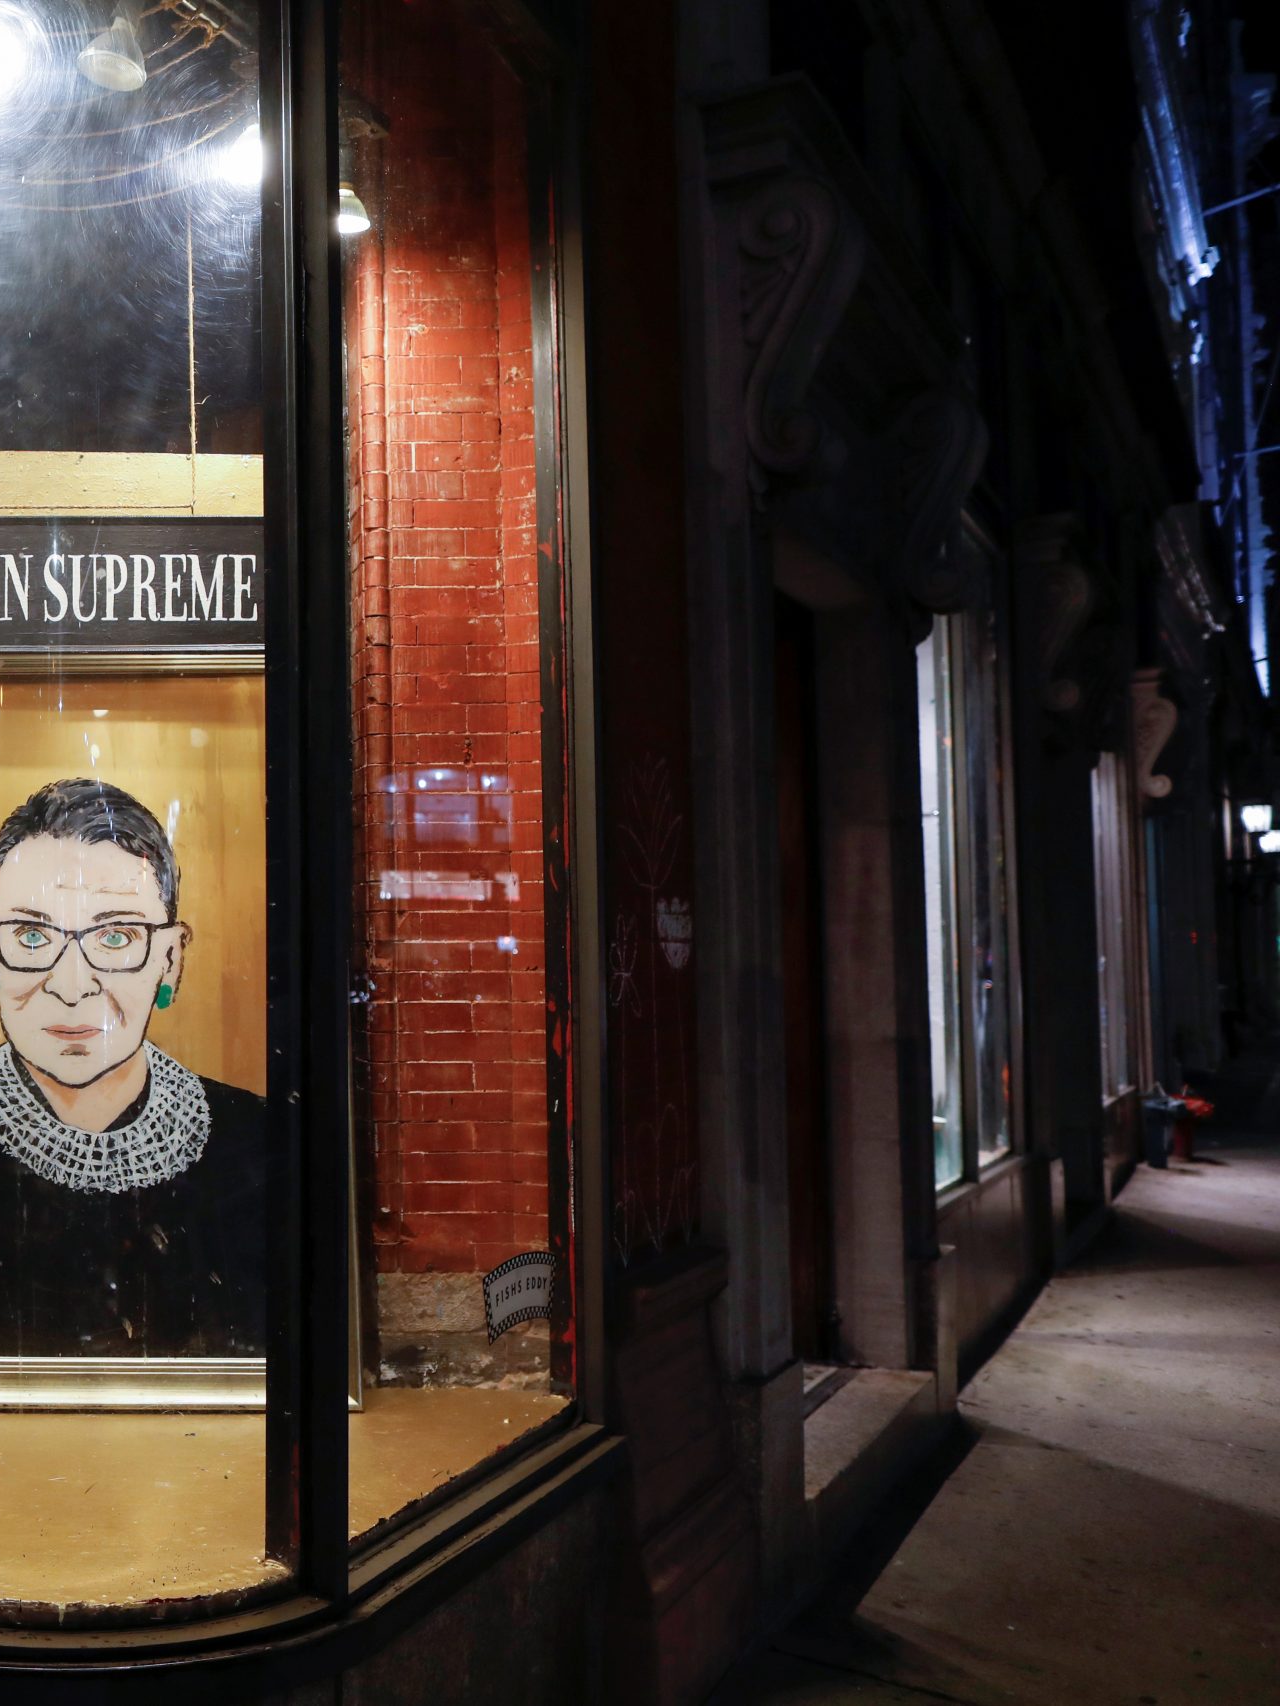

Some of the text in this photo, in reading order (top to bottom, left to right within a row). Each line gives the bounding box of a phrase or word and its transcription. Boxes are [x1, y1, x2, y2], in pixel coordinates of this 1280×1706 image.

[43, 553, 258, 623] SUPREME
[495, 1276, 548, 1308] FISHS EDDY
